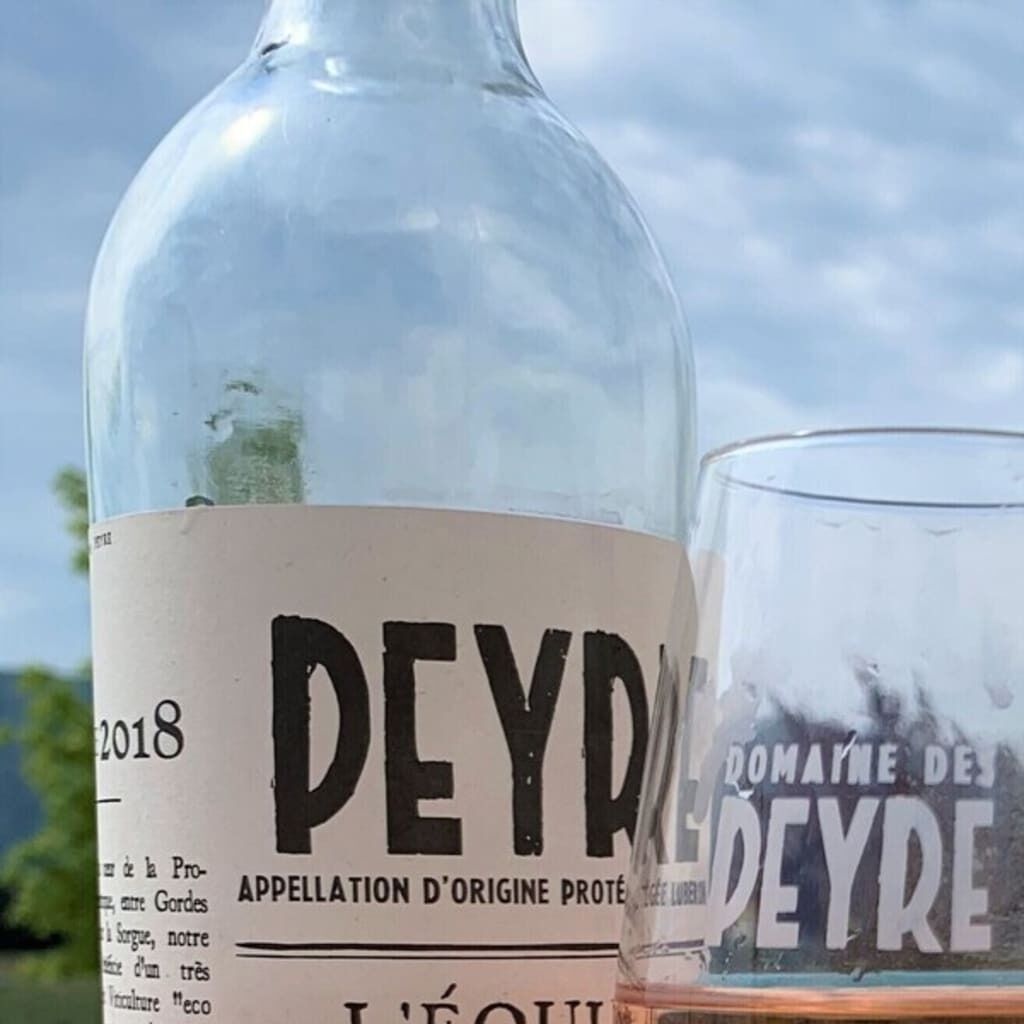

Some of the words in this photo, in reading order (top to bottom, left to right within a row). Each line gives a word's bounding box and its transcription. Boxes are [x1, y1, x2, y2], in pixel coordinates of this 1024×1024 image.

[100, 699, 184, 760] 2018
[725, 742, 898, 785] DOMAINE
[924, 744, 997, 788] DES
[172, 856, 207, 879] Pro-
[703, 795, 994, 953] PEYRE
[155, 889, 208, 912] Gordes
[237, 875, 410, 904] APPELLATION
[423, 875, 549, 904] D'ORIGINE
[168, 930, 209, 947] notre
[180, 961, 210, 980] très
[173, 991, 211, 1014] "eco
